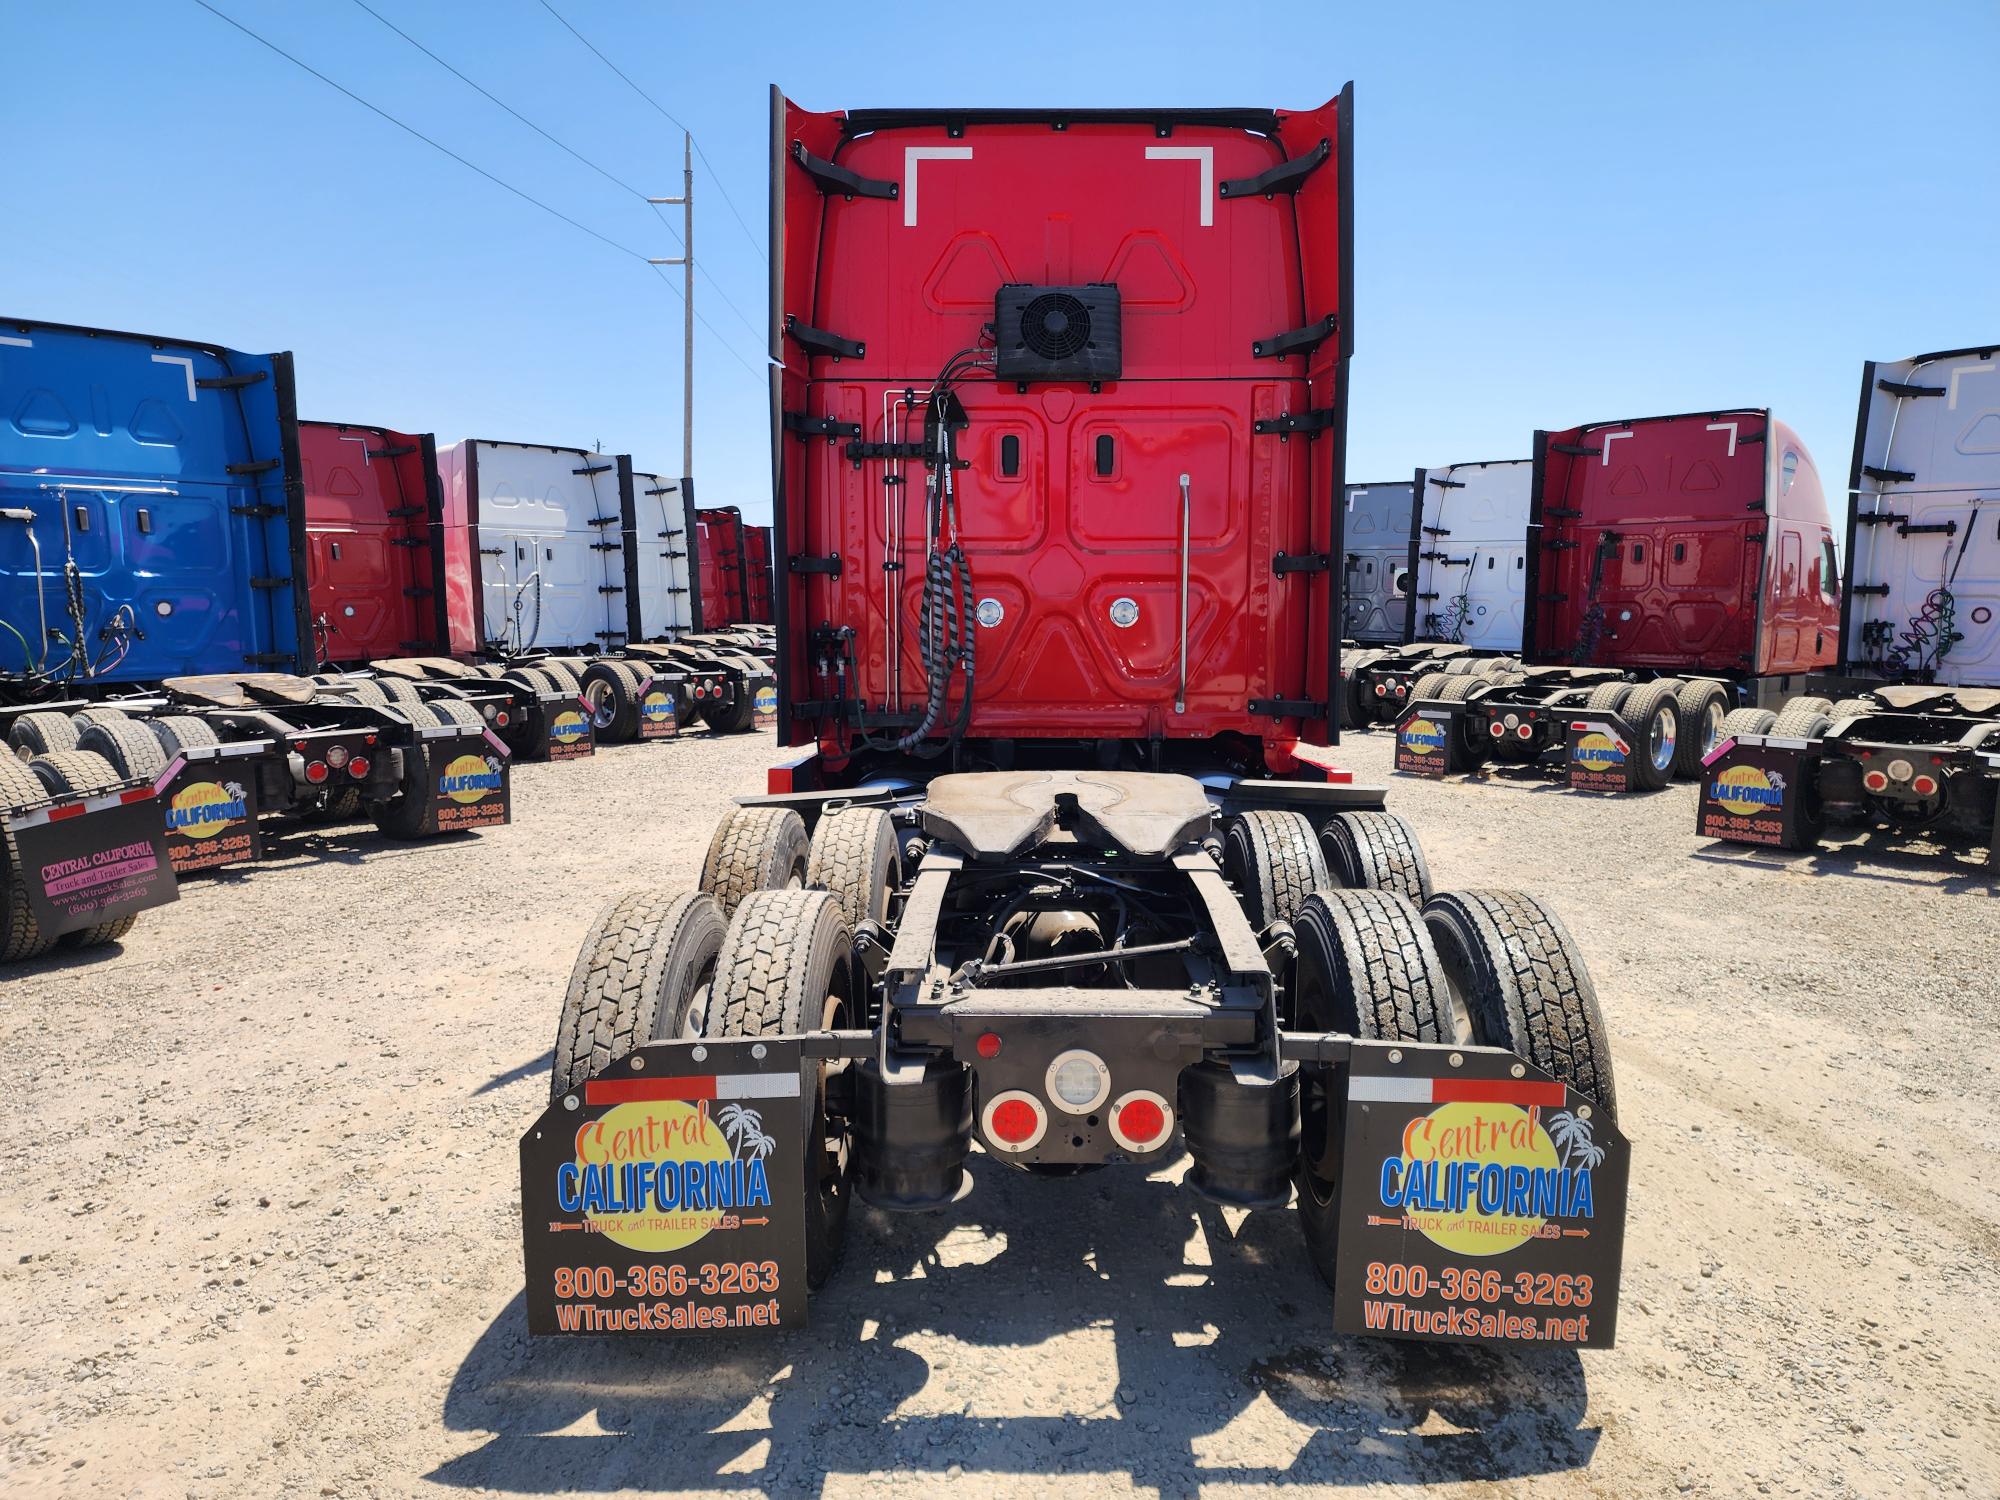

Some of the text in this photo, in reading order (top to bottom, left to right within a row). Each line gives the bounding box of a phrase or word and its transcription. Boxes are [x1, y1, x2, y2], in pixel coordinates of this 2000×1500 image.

[440, 772, 502, 793] CALIFORNIA
[1711, 782, 1784, 805] CALIFORNIA
[165, 800, 246, 829] CALIFORNIA
[438, 803, 504, 821] 800-366-3263
[1705, 814, 1783, 834] 800-366-3263
[1704, 826, 1781, 845] WTruckSales.net
[41, 840, 154, 882] CENTRAL CALIFORNIA
[54, 860, 149, 892] Truck and Trailer Sales
[68, 886, 148, 916] (800) 366-3263
[576, 1098, 710, 1168] Central
[1402, 1104, 1542, 1164] Central
[557, 1158, 773, 1213] CALIFORNIA
[1380, 1156, 1594, 1219] CALIFORNIA
[582, 1215, 741, 1233] TRUCK and TRAILER SALES
[1401, 1215, 1561, 1240] TRUCK and TRAILER SALES
[554, 1261, 780, 1299] 800-366-3263
[1365, 1262, 1593, 1308] 800-366-3263
[555, 1298, 780, 1332] WTruckSales.net
[1364, 1301, 1590, 1342] WTruckSales.net
